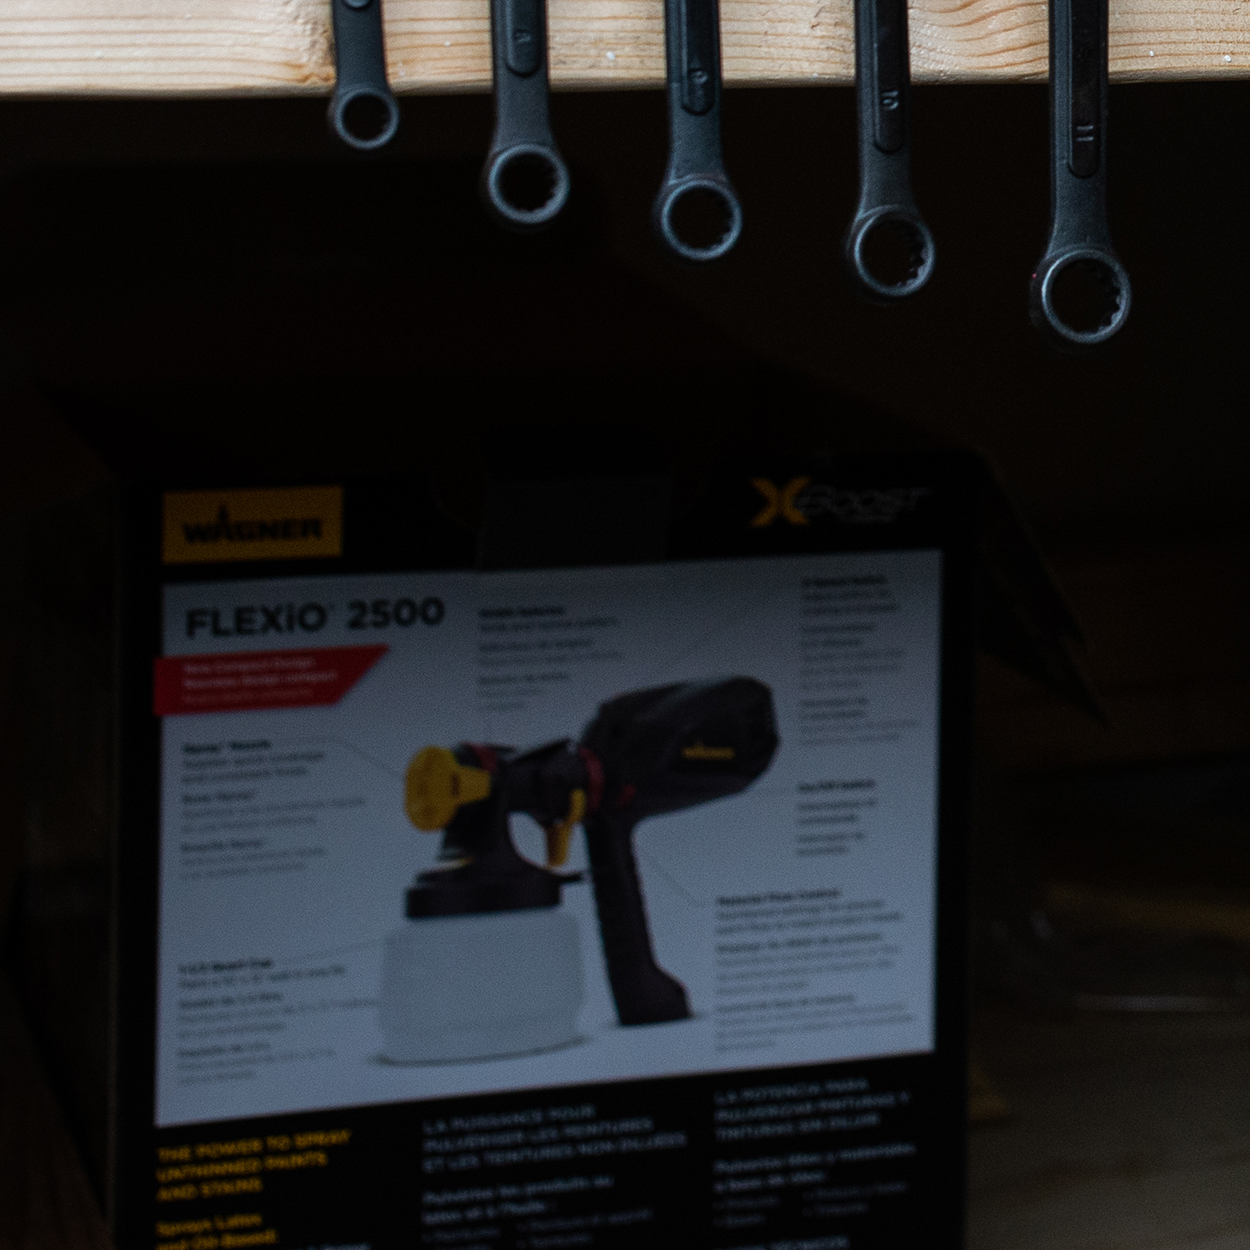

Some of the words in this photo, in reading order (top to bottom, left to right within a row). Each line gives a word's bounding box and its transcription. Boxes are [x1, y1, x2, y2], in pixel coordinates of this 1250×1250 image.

[881, 89, 899, 111] 10
[183, 503, 323, 545] WAGNER
[347, 597, 446, 629] 2500
